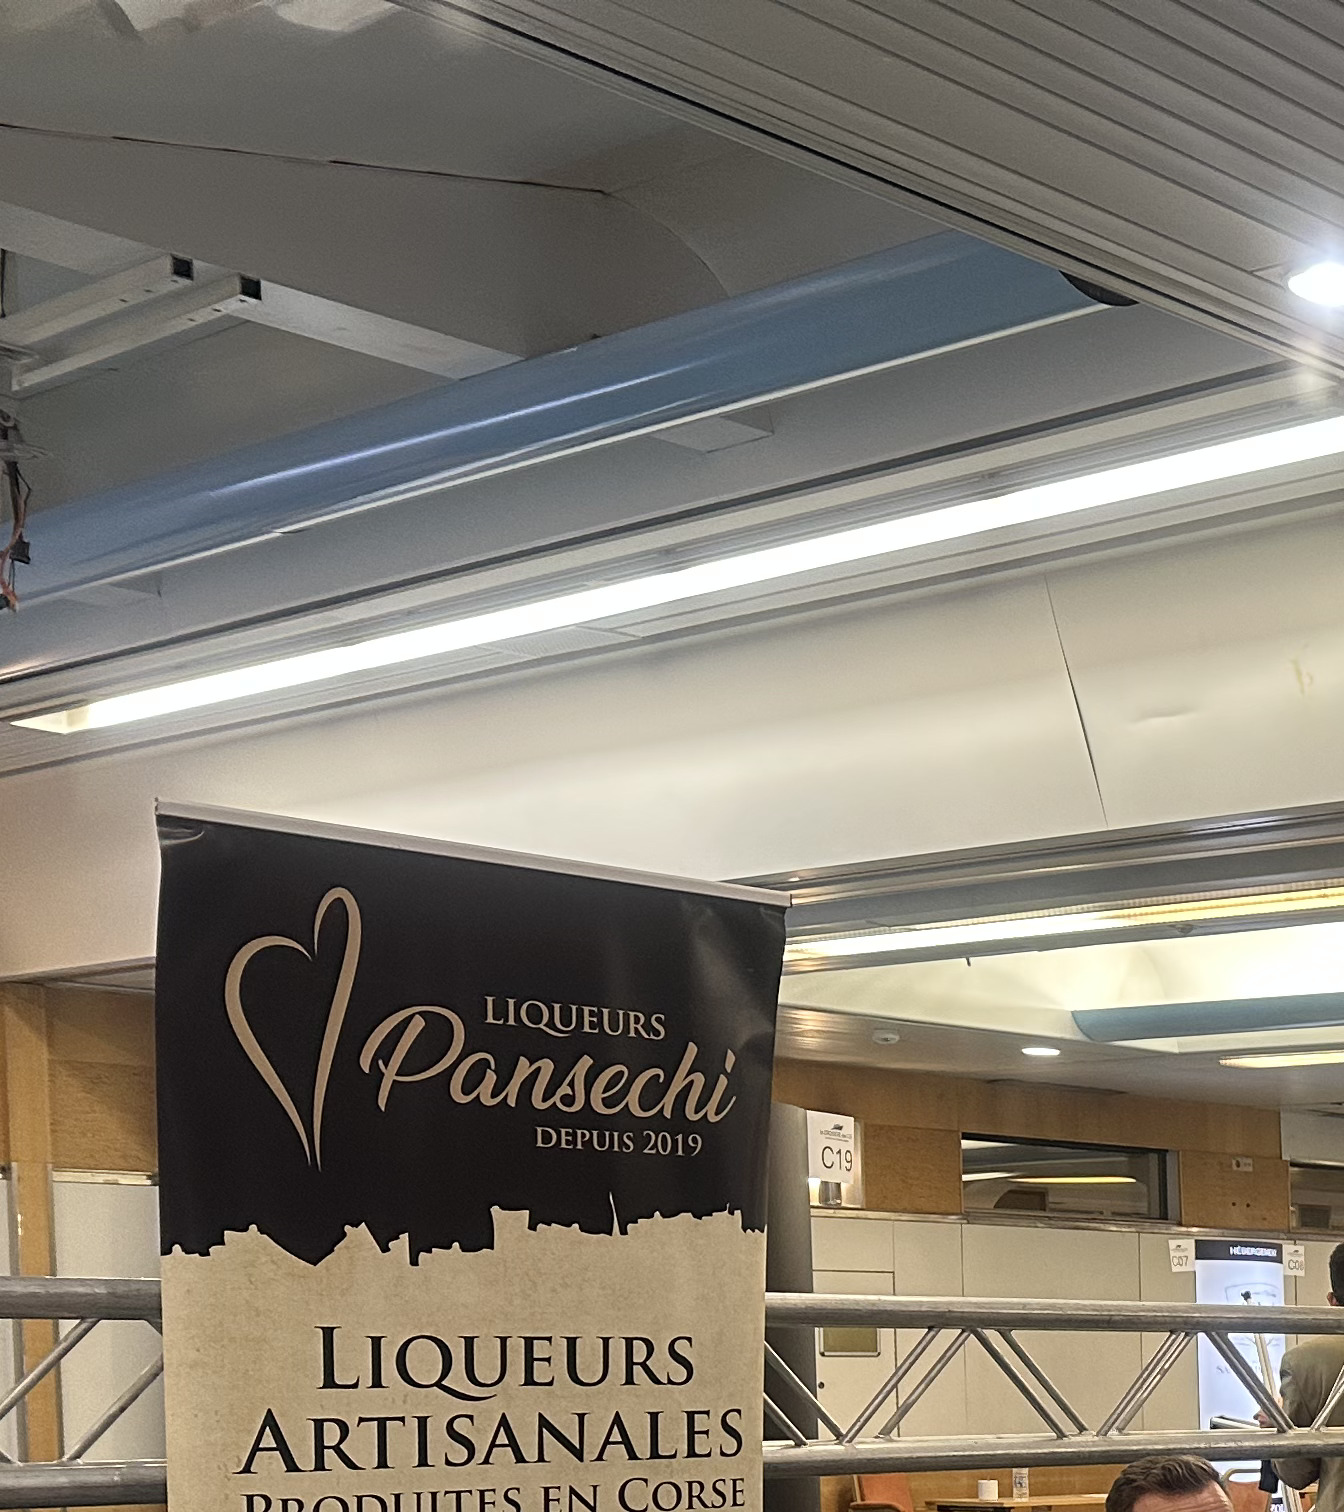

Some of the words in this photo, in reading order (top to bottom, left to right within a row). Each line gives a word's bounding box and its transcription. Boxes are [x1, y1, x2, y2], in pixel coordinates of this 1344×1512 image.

[484, 996, 666, 1040] LIQUEURS
[360, 1005, 736, 1123] Pansechi
[536, 1126, 634, 1154] DEPUIS
[643, 1130, 702, 1156] 2019
[821, 1145, 853, 1172] C19
[1172, 1255, 1188, 1267] C07
[315, 1325, 695, 1402] LIQUEURS
[233, 1407, 744, 1474] ARTISANALES
[618, 1477, 746, 1512] CORSE
